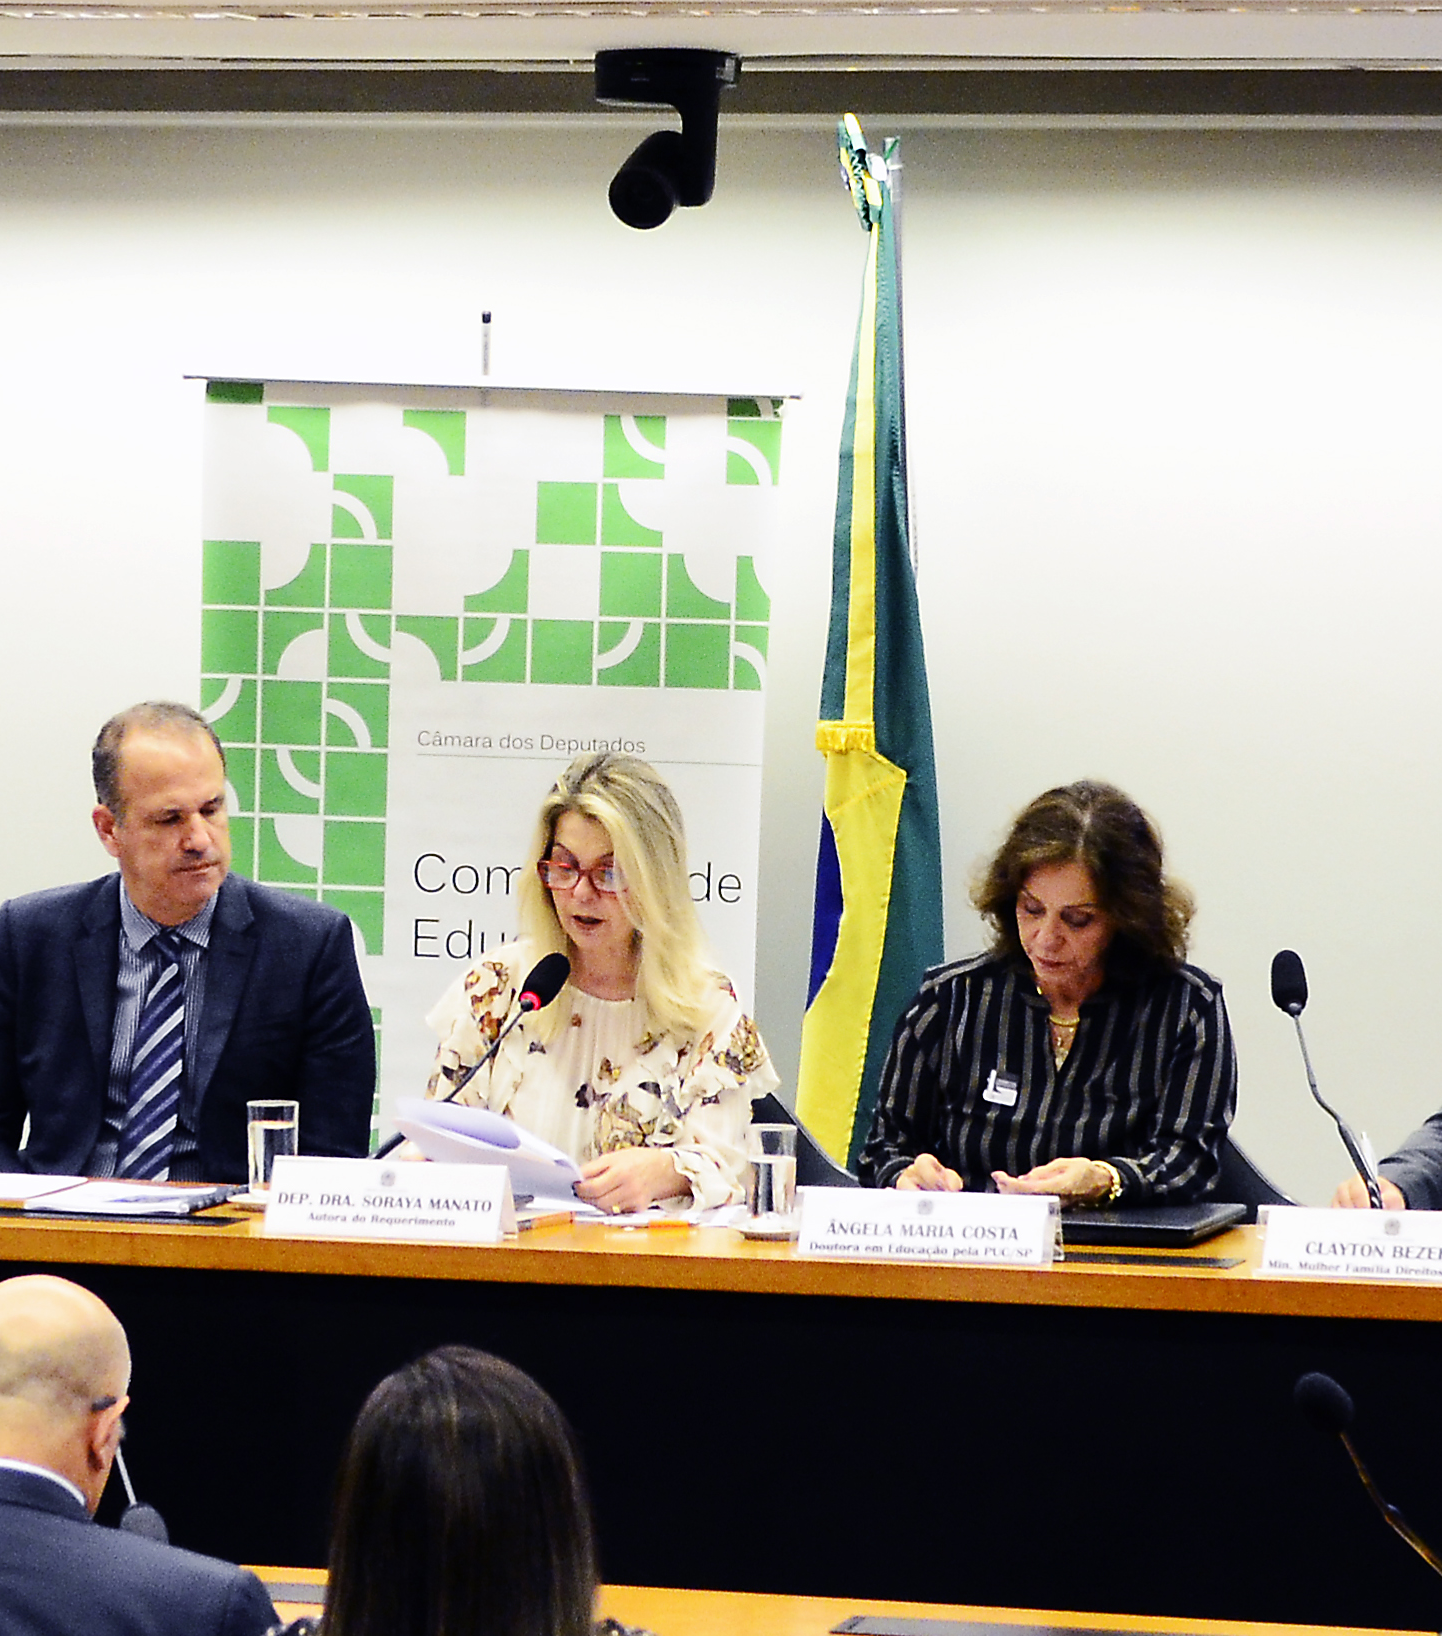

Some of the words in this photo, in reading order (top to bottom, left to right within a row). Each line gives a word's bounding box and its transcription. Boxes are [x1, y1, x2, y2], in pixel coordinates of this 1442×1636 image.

[417, 730, 492, 749] Câmara
[499, 734, 534, 750] dos
[540, 734, 646, 754] Deputados
[689, 862, 742, 902] de
[278, 1192, 312, 1205] DEP.
[319, 1194, 355, 1207] DRA.
[363, 1196, 422, 1209] SORAYA
[428, 1199, 492, 1212] MANATO
[308, 1212, 347, 1223] Autora
[352, 1214, 366, 1223] do
[371, 1215, 456, 1227] Requerimento
[827, 1219, 893, 1237] ÂNGELA
[900, 1224, 954, 1238] MARIA
[962, 1225, 1018, 1240] COSTA
[809, 1242, 859, 1251] Doutora
[888, 1244, 948, 1258] Educação
[953, 1247, 979, 1258] pela
[984, 1248, 1032, 1258] PUC/SP
[1305, 1241, 1385, 1258] CLAYTON
[1268, 1260, 1292, 1269] Min.
[1298, 1263, 1341, 1272] Mulher
[1395, 1266, 1442, 1277] Direitos
